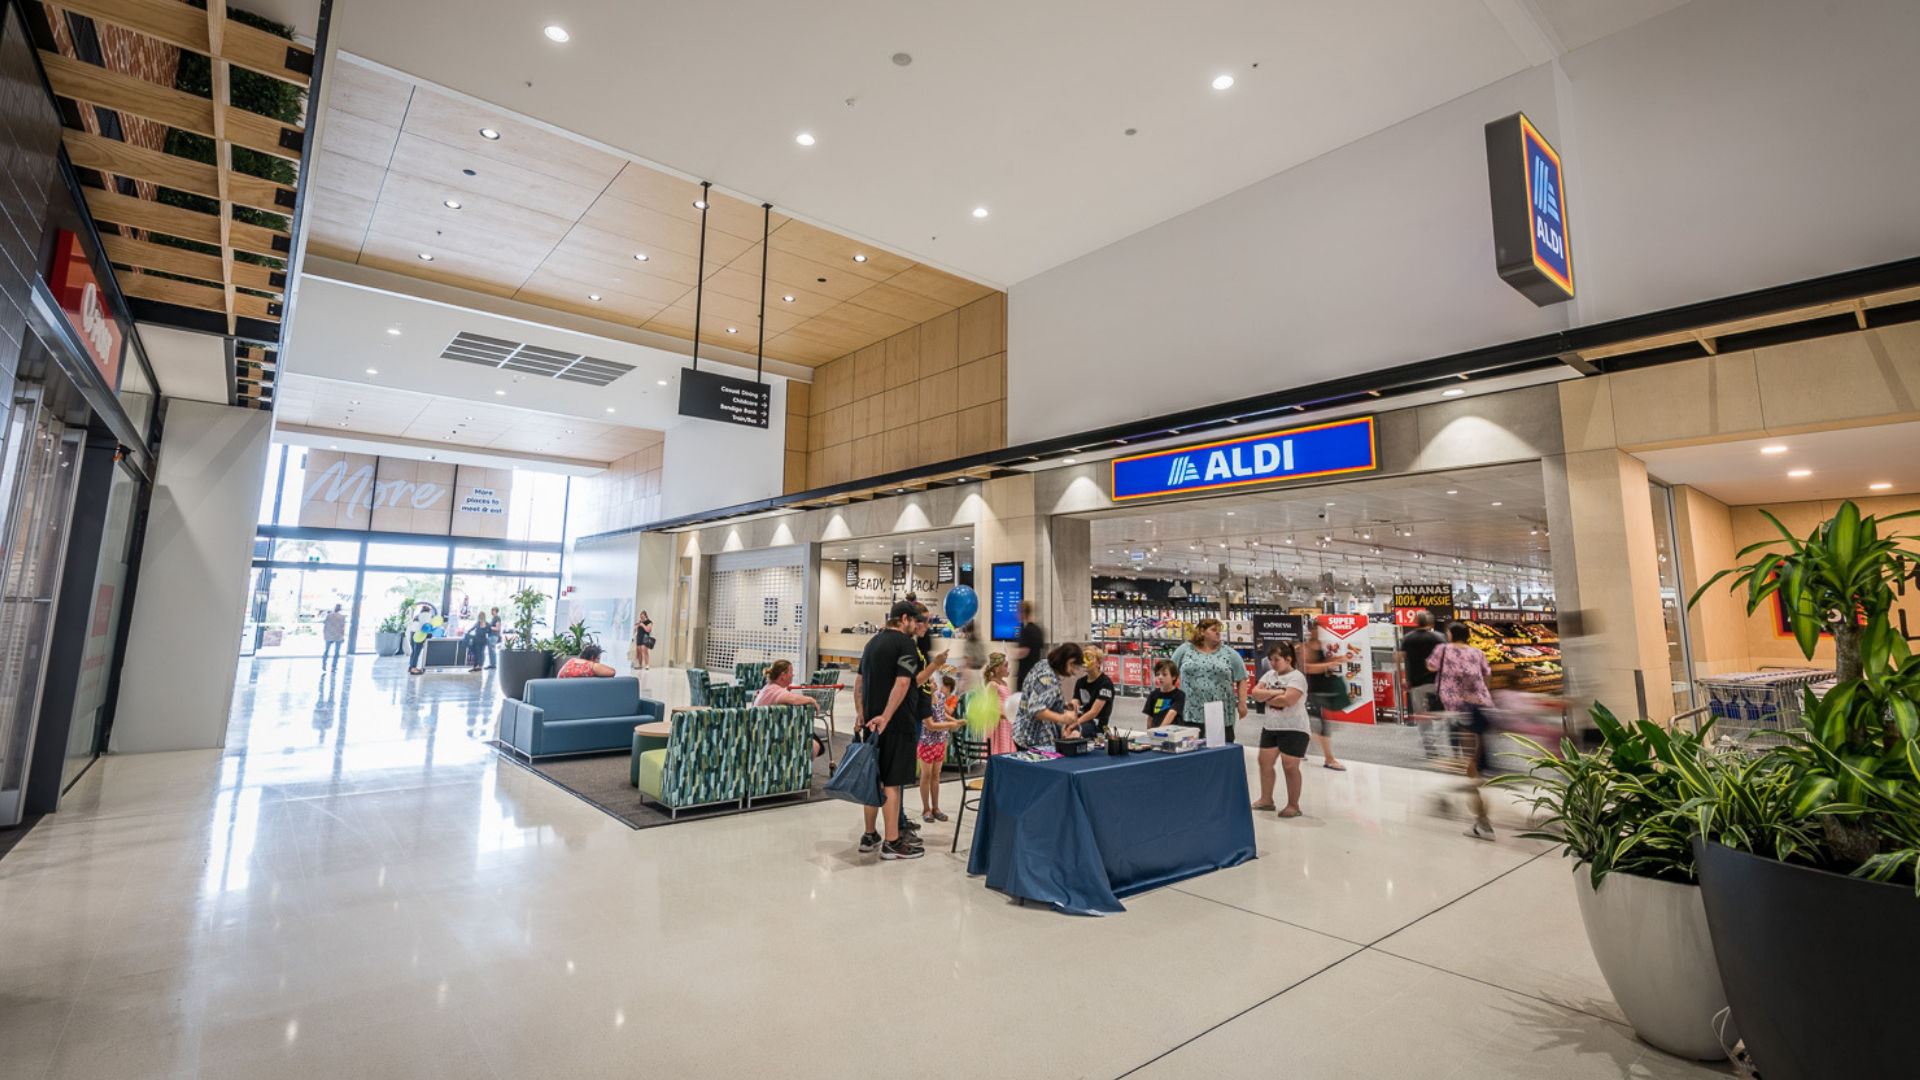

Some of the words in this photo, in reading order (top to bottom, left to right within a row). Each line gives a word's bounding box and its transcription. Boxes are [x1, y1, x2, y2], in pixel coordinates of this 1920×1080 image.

[1536, 215, 1564, 260] ALDI
[721, 386, 740, 395] Casual
[741, 389, 758, 398] Dining
[732, 397, 758, 406] Childcare
[720, 403, 742, 413] Bendigo
[1204, 439, 1295, 481] ALDI
[300, 461, 446, 519] More
[1395, 587, 1450, 595] BANANAS
[1395, 595, 1418, 606] 100%
[1419, 595, 1451, 606] AUSSIE
[1328, 617, 1355, 625] SUPER
[1396, 610, 1418, 623] 1.9
